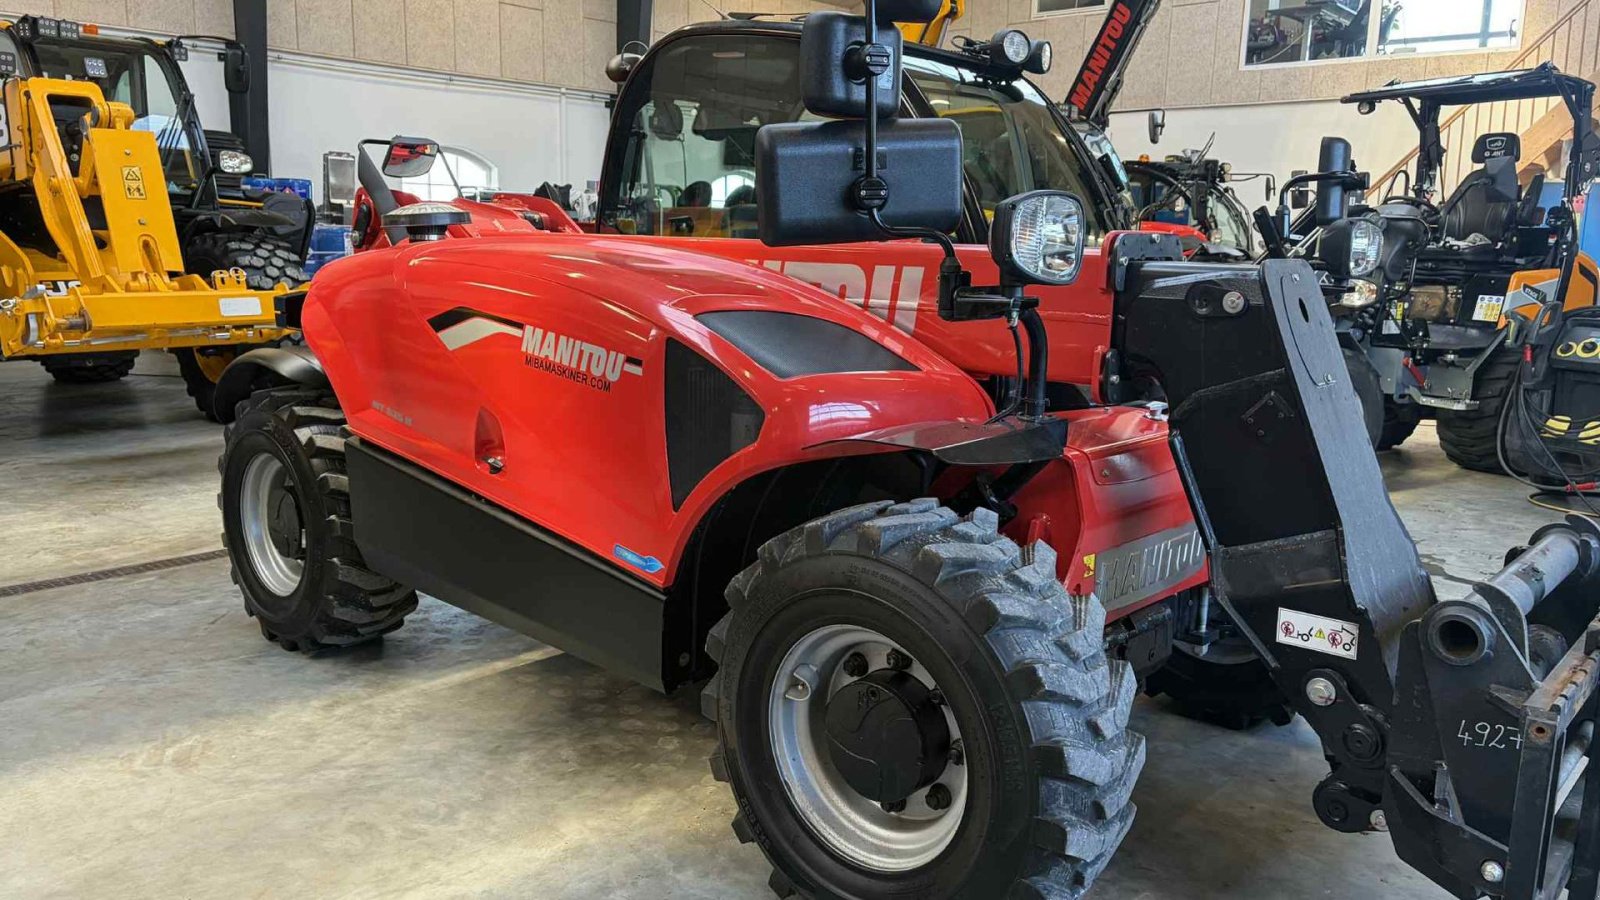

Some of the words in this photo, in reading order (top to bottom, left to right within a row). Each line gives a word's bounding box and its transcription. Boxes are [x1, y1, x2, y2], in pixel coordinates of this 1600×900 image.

[1070, 2, 1131, 110] MANITOU
[521, 325, 627, 382] MANITOU
[525, 355, 612, 393] MIBAMASKINER.COM
[1457, 719, 1524, 750] 4927
